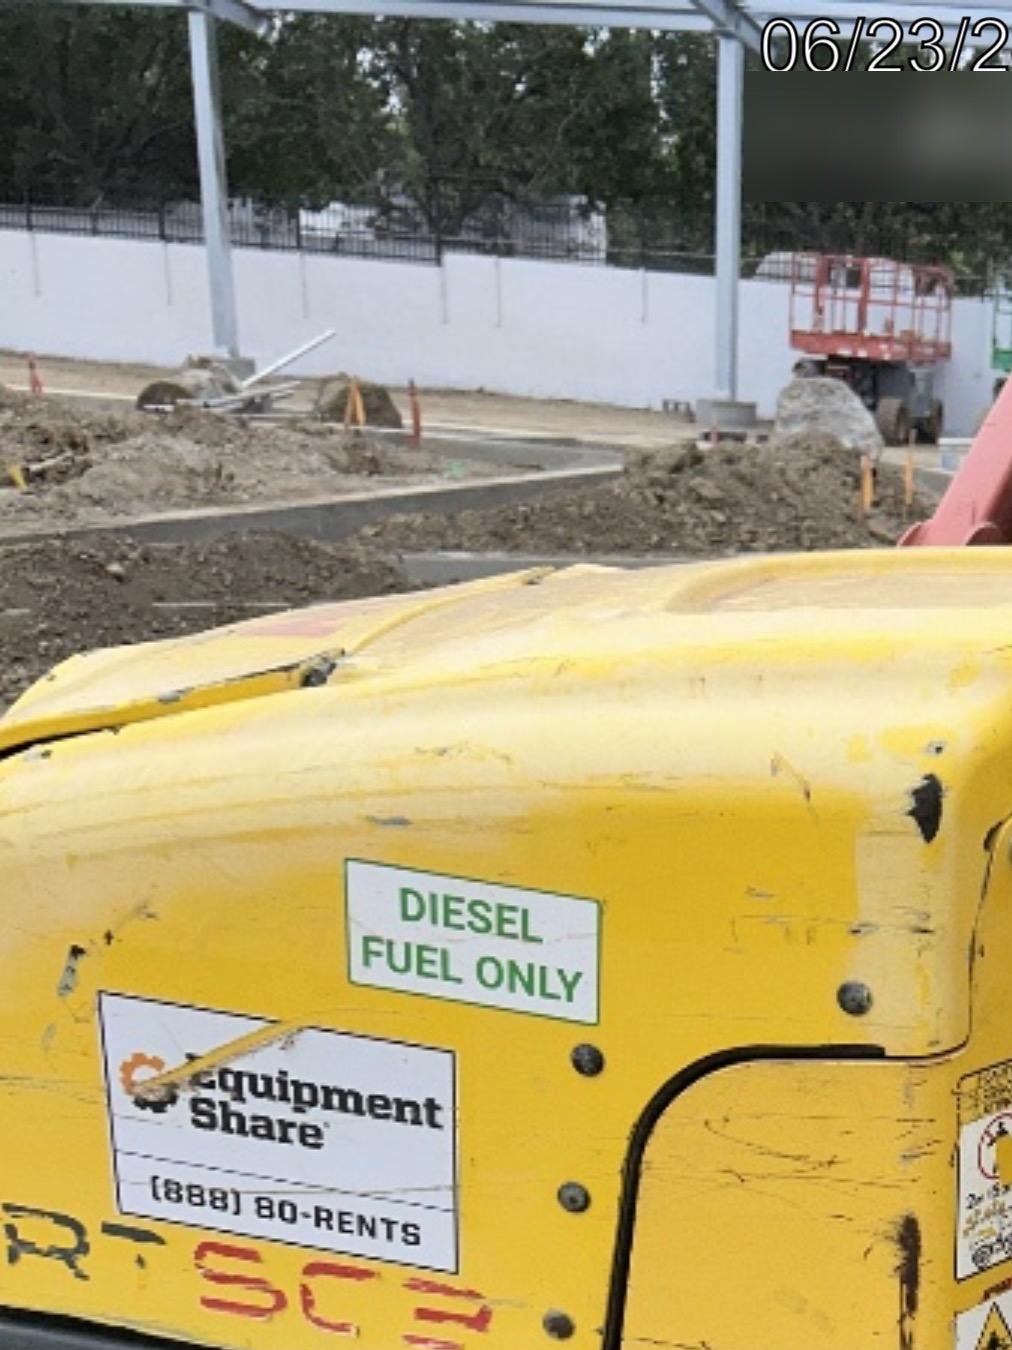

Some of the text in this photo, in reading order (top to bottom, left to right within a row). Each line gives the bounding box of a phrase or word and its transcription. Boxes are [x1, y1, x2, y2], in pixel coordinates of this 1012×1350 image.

[400, 887, 544, 945] DIESEL
[362, 935, 583, 1003] FUEL ONLY
[151, 1175, 421, 1246] (888) 80-RENTS
